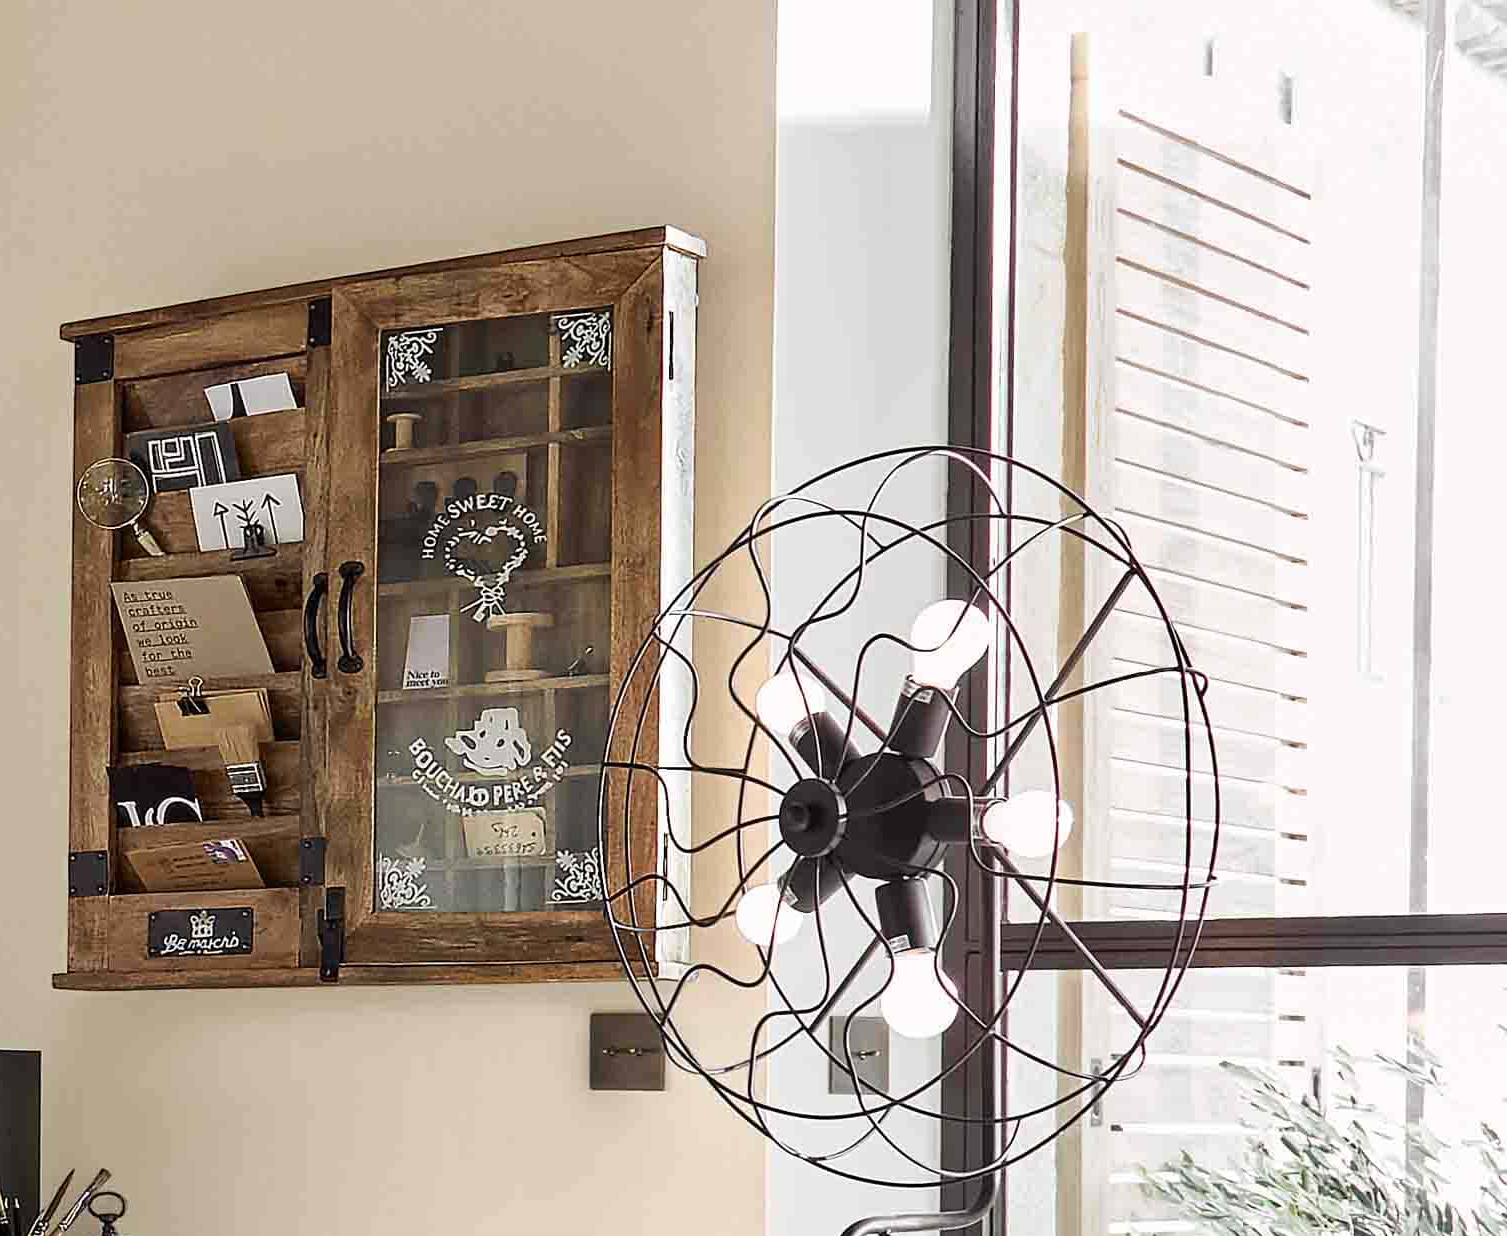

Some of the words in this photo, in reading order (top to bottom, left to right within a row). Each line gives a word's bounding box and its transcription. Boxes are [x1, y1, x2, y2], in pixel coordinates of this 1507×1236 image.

[421, 514, 451, 559] HOME
[447, 494, 513, 519] SWEET
[513, 504, 549, 544] HOME
